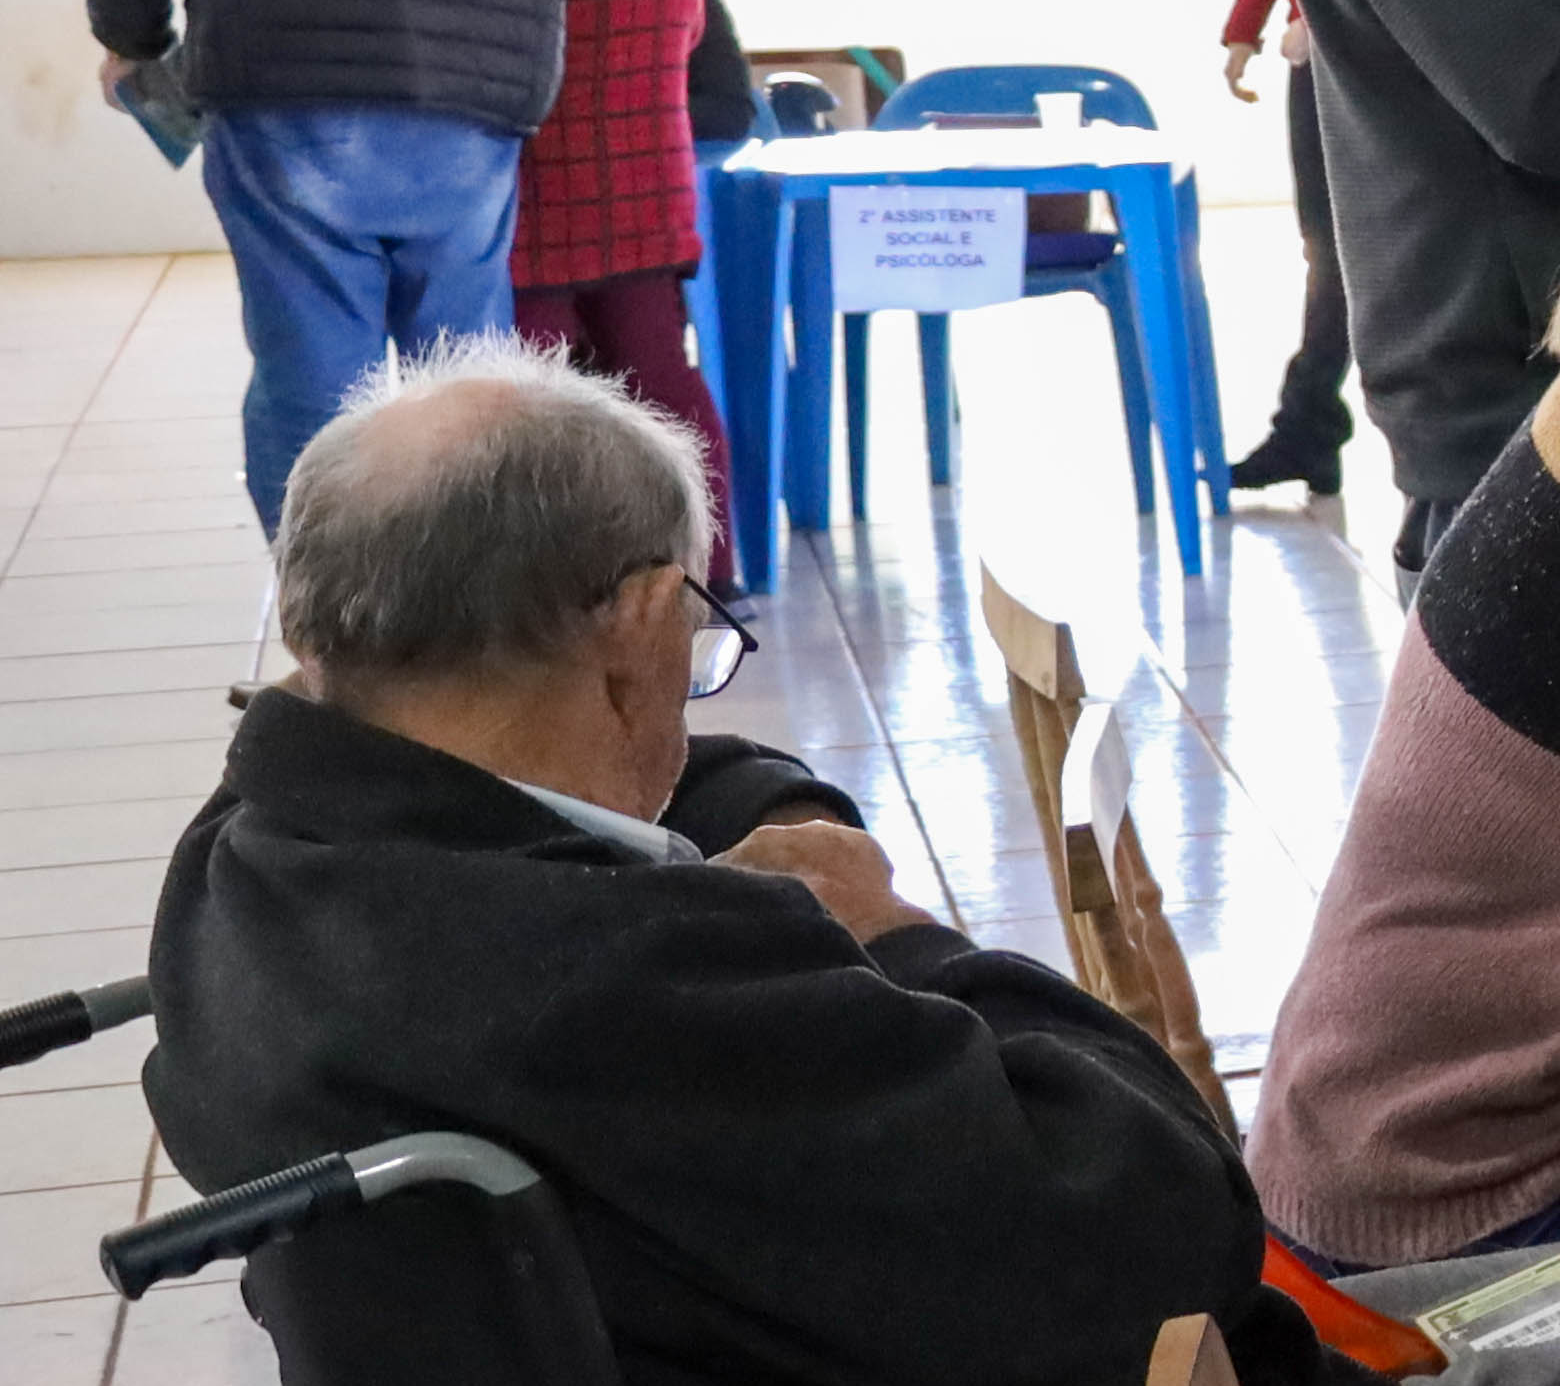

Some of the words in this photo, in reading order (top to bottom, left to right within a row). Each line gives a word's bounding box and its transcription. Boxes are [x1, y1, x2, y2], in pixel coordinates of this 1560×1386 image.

[880, 208, 997, 223] ASSISTENTE
[886, 231, 954, 246] SOCIAL
[960, 231, 973, 245] E
